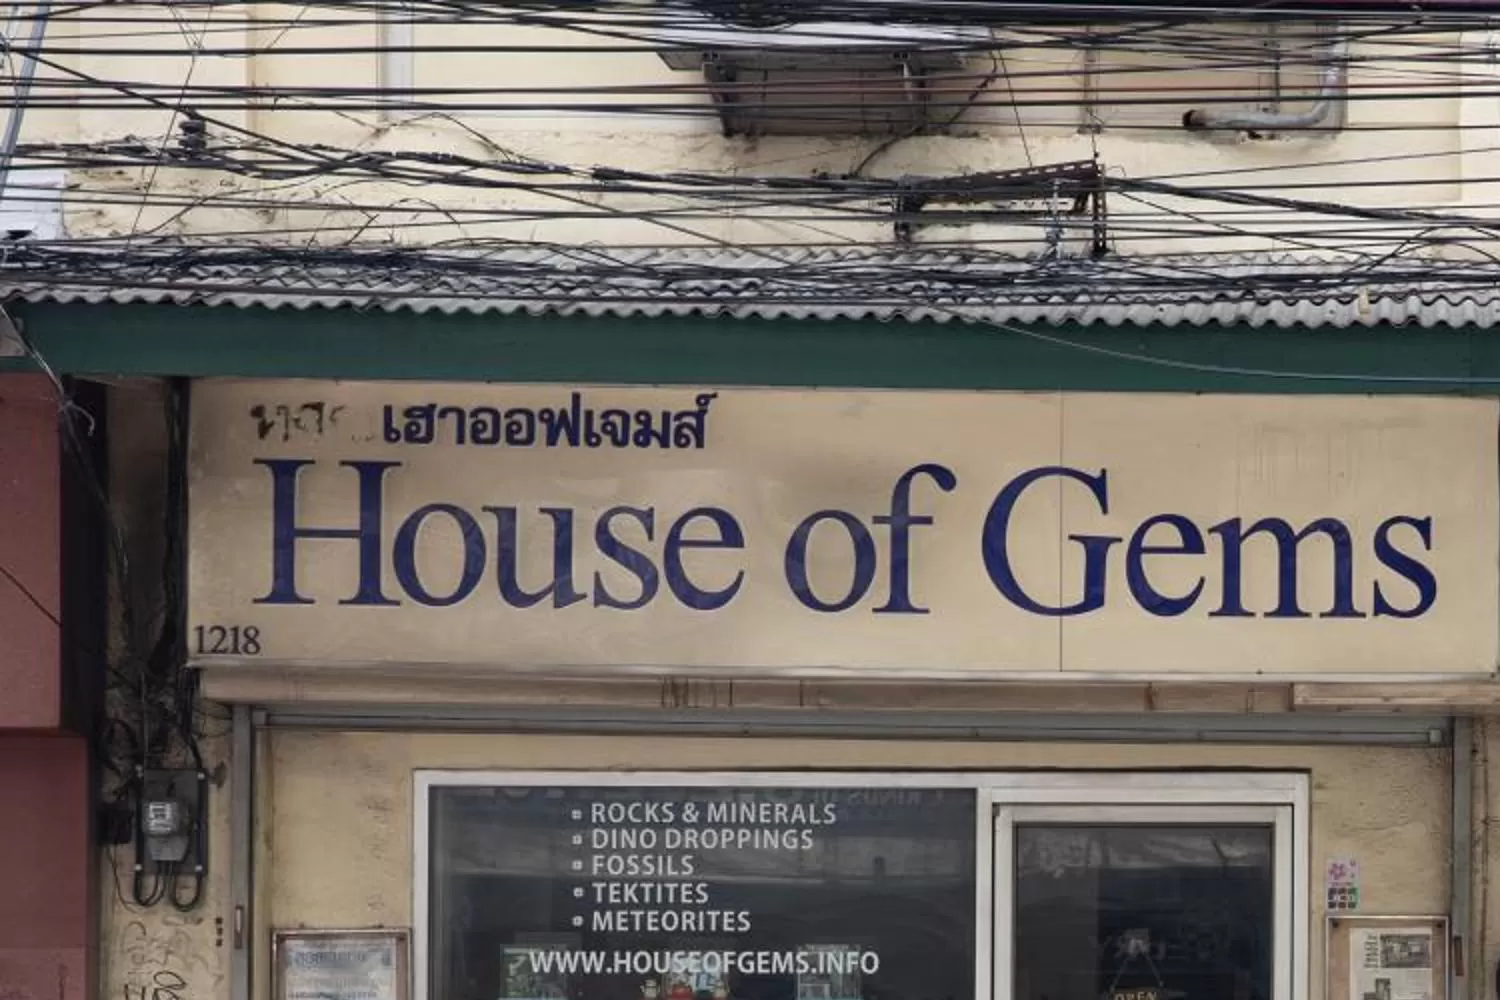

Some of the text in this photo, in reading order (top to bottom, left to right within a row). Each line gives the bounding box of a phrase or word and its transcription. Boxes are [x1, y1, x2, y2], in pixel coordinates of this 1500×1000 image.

[383, 392, 718, 449] เฮาออฟเจมส์
[252, 457, 1438, 619] House of Gems
[194, 624, 261, 655] 1218
[591, 802, 837, 824] ROCKS & MINERALS
[591, 828, 814, 850] DINO DROPPINGS
[592, 854, 695, 876] FOSSILS
[592, 883, 709, 904] TEKTITES
[591, 910, 751, 932] METEORITES
[529, 950, 880, 975] WWW.HOUSEOFGEMS.INFO
